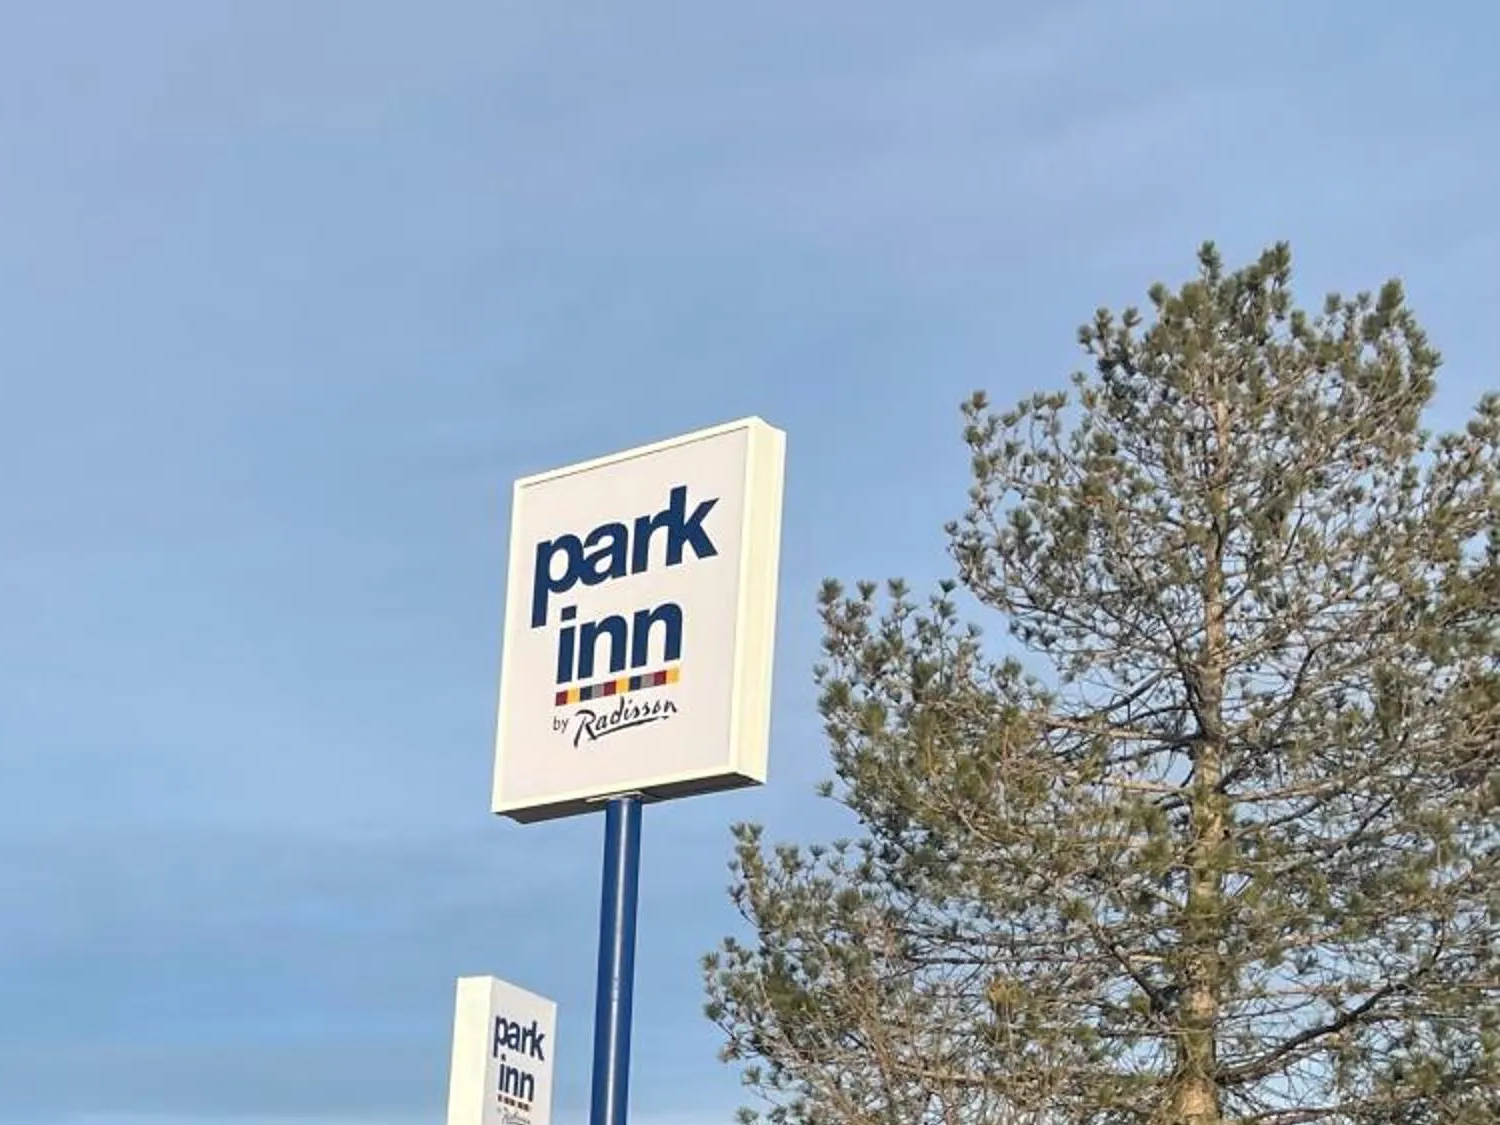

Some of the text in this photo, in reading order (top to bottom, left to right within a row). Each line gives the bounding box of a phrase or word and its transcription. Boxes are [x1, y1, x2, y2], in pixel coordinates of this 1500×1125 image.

[531, 485, 719, 628] park
[556, 603, 684, 685] inn
[553, 696, 679, 748] by Radisson
[493, 1015, 545, 1061] park
[498, 1053, 535, 1102] inn
